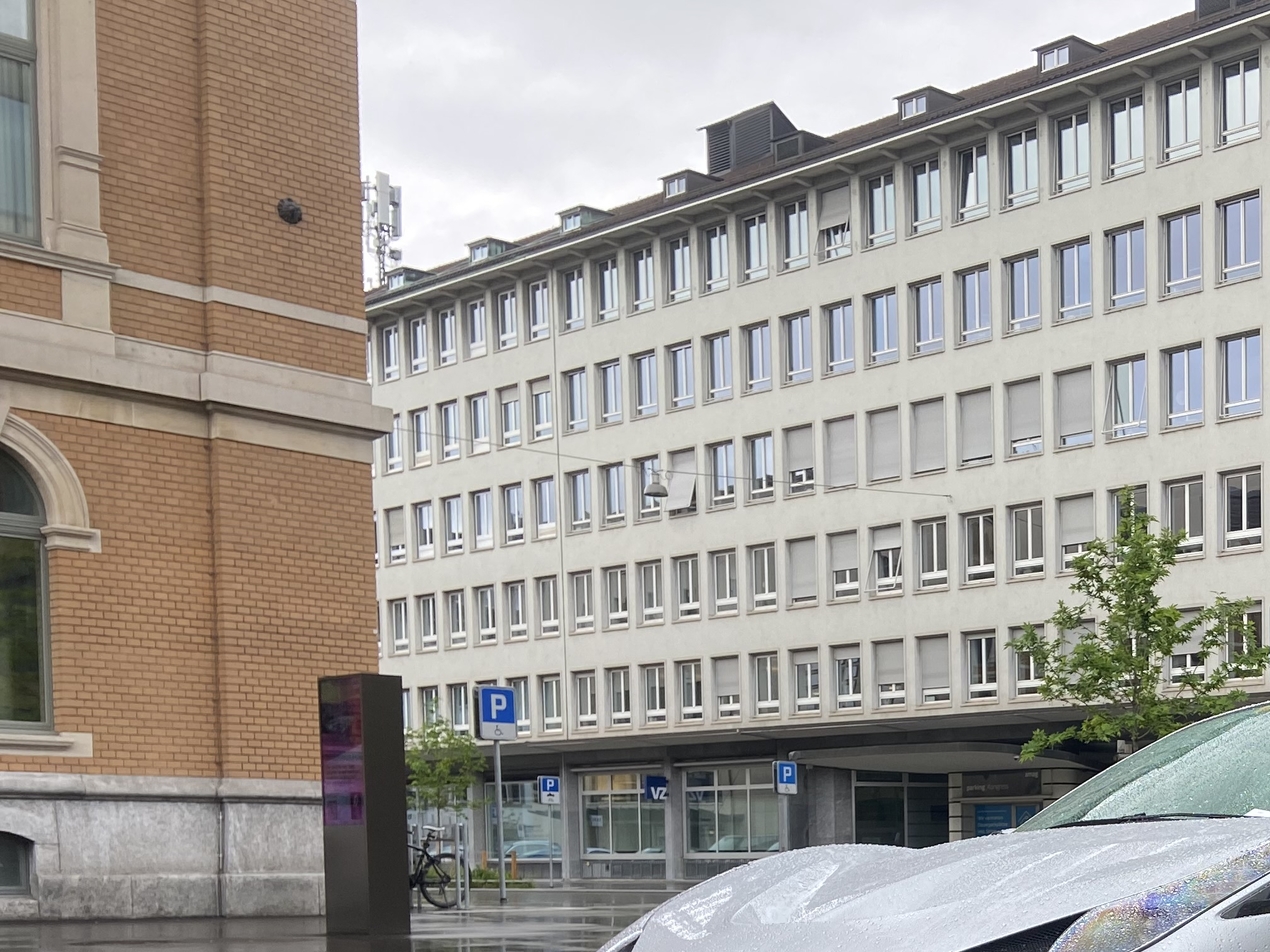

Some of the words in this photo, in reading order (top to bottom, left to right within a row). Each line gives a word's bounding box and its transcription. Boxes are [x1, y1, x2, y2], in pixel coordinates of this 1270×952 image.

[491, 693, 507, 719] P
[783, 766, 791, 782] P
[546, 778, 554, 791] P
[651, 787, 667, 799] VZ
